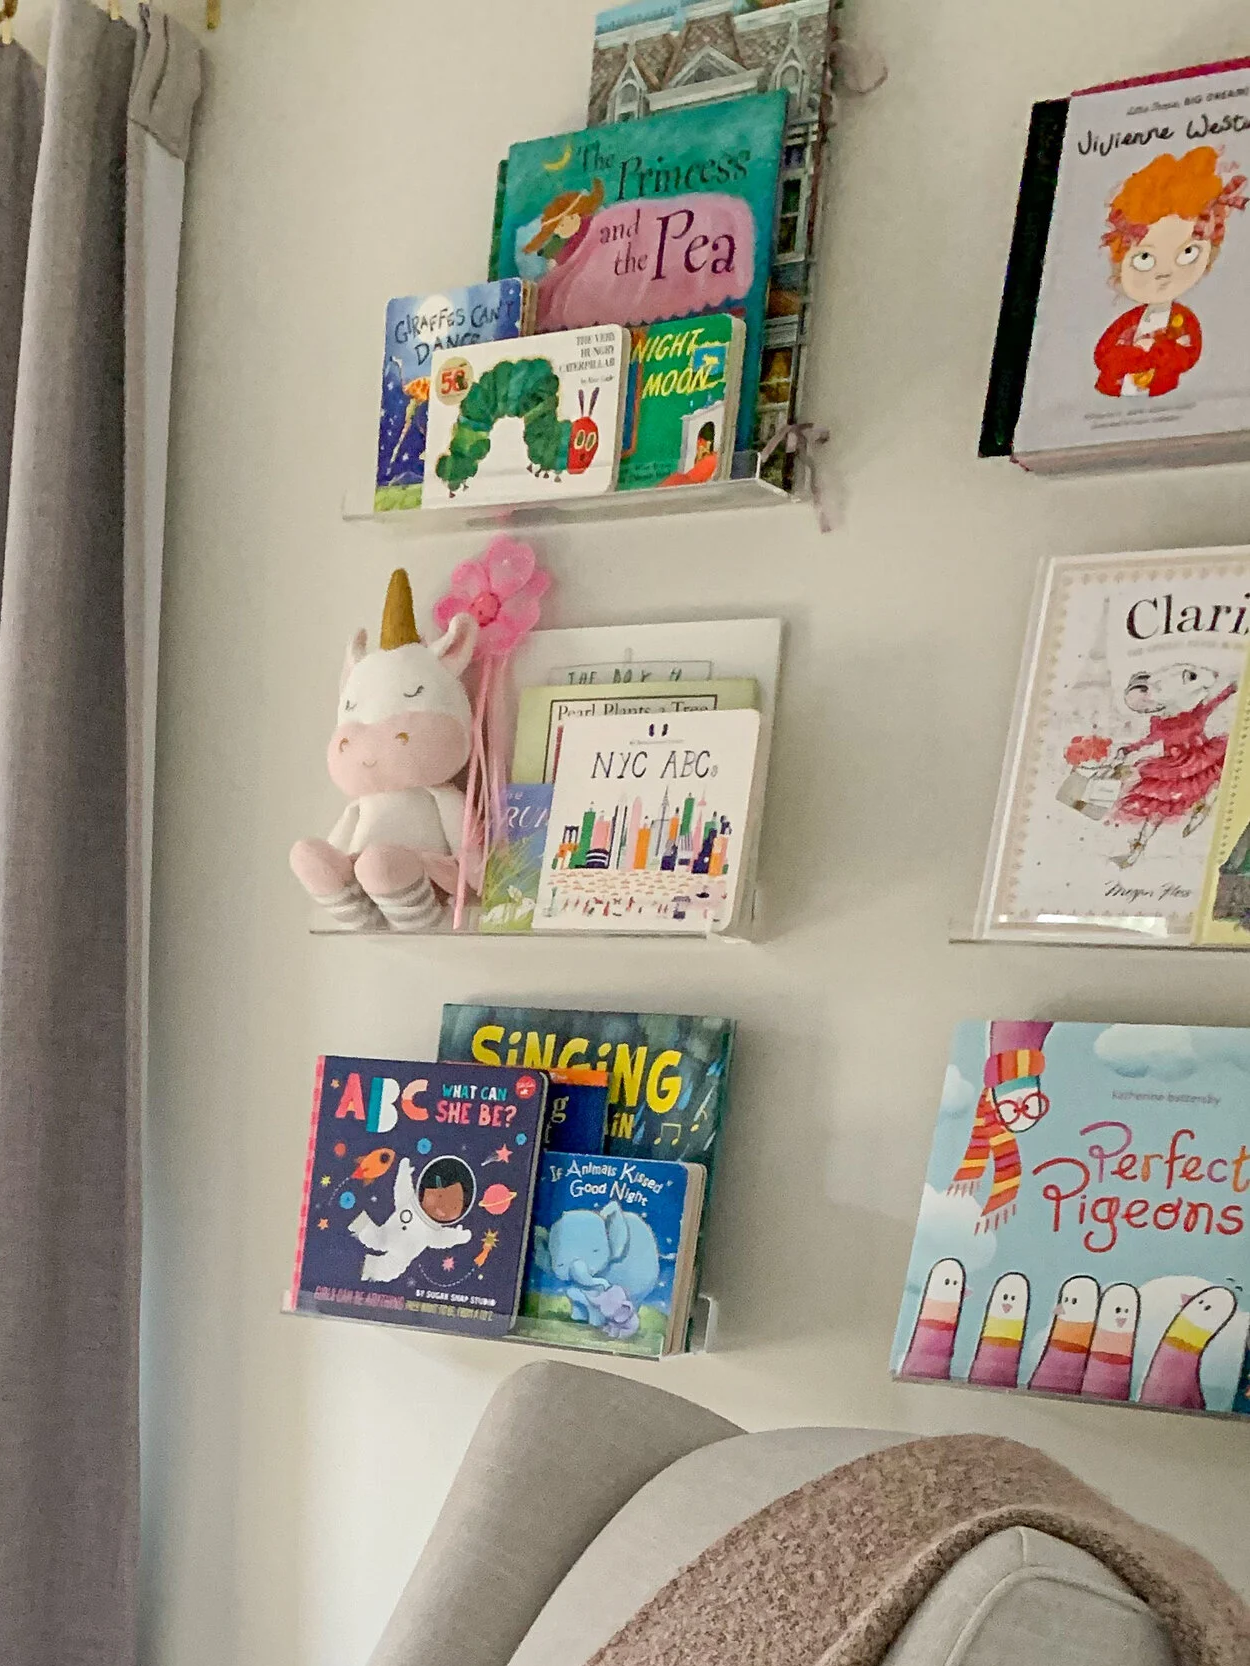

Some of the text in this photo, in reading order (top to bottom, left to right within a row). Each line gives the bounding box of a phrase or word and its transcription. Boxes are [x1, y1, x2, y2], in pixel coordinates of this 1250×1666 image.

[1078, 126, 1175, 157] Vivienne
[578, 140, 751, 201] The Princess
[600, 208, 736, 281] and the Pea
[394, 307, 466, 344] GIRAFFES
[631, 328, 705, 364] NIGHT
[641, 365, 713, 400] MOON
[1126, 593, 1250, 640] Clari
[591, 751, 649, 779] NYC
[335, 1072, 508, 1134] ABC WHAT CAN
[435, 1100, 518, 1128] SHE BE?
[1079, 1120, 1250, 1193] Perfect
[565, 1160, 618, 1178] Animals
[619, 1162, 664, 1195] Kissed
[569, 1178, 649, 1207] Good Night
[1032, 1156, 1244, 1254] Pigeons
